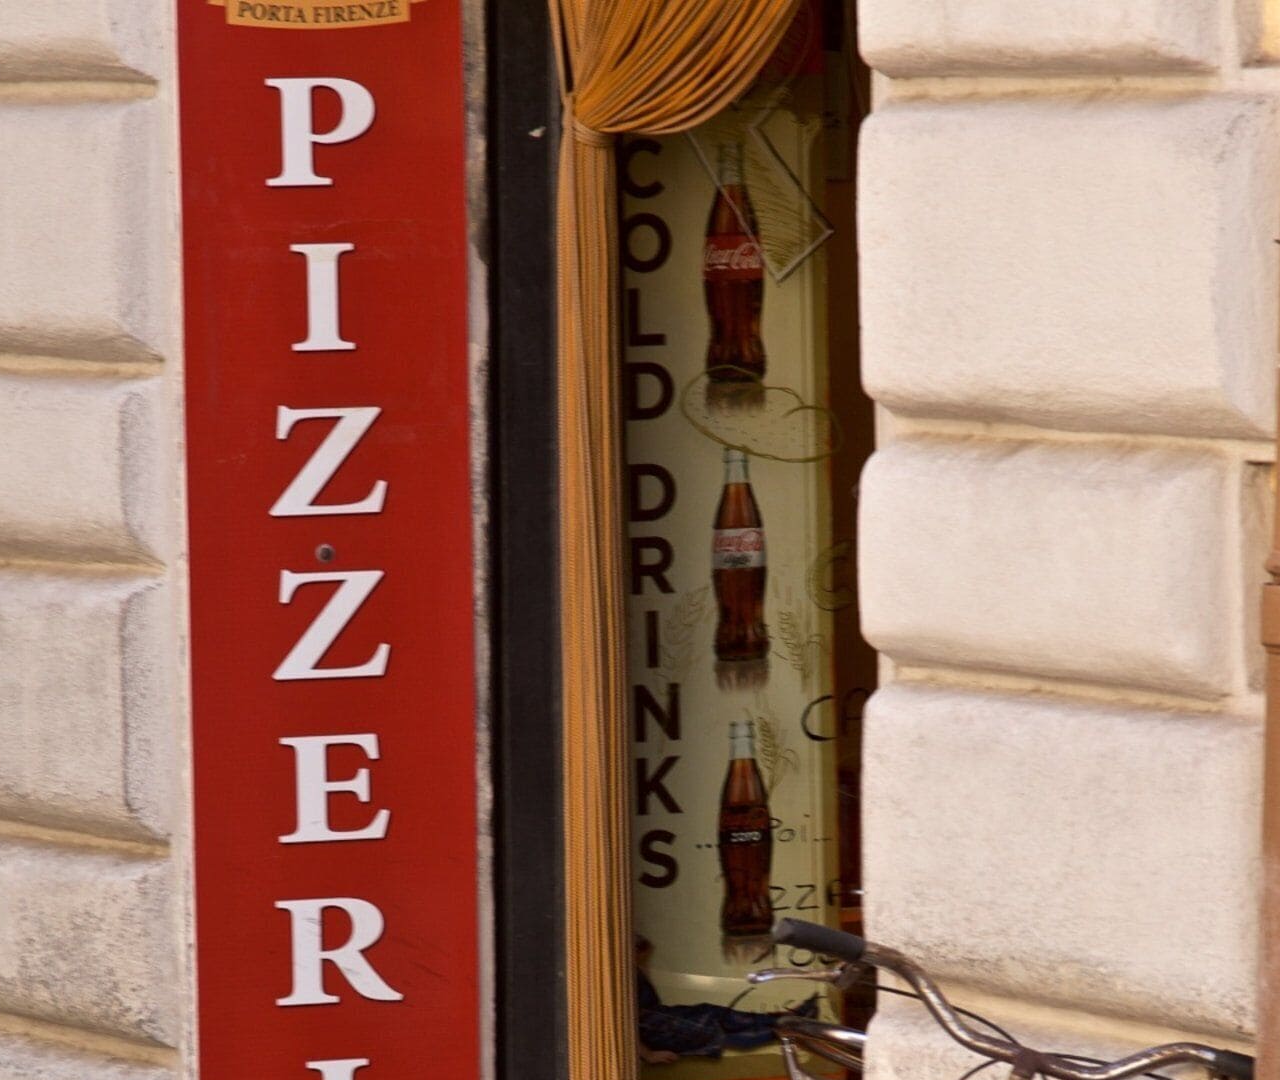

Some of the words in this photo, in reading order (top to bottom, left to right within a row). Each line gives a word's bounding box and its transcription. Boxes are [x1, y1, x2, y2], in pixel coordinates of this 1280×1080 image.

[236, 0, 308, 23] PORTA
[312, 0, 400, 23] FIRENZE
[618, 138, 675, 421] COLD
[620, 463, 684, 889] DRINKS
